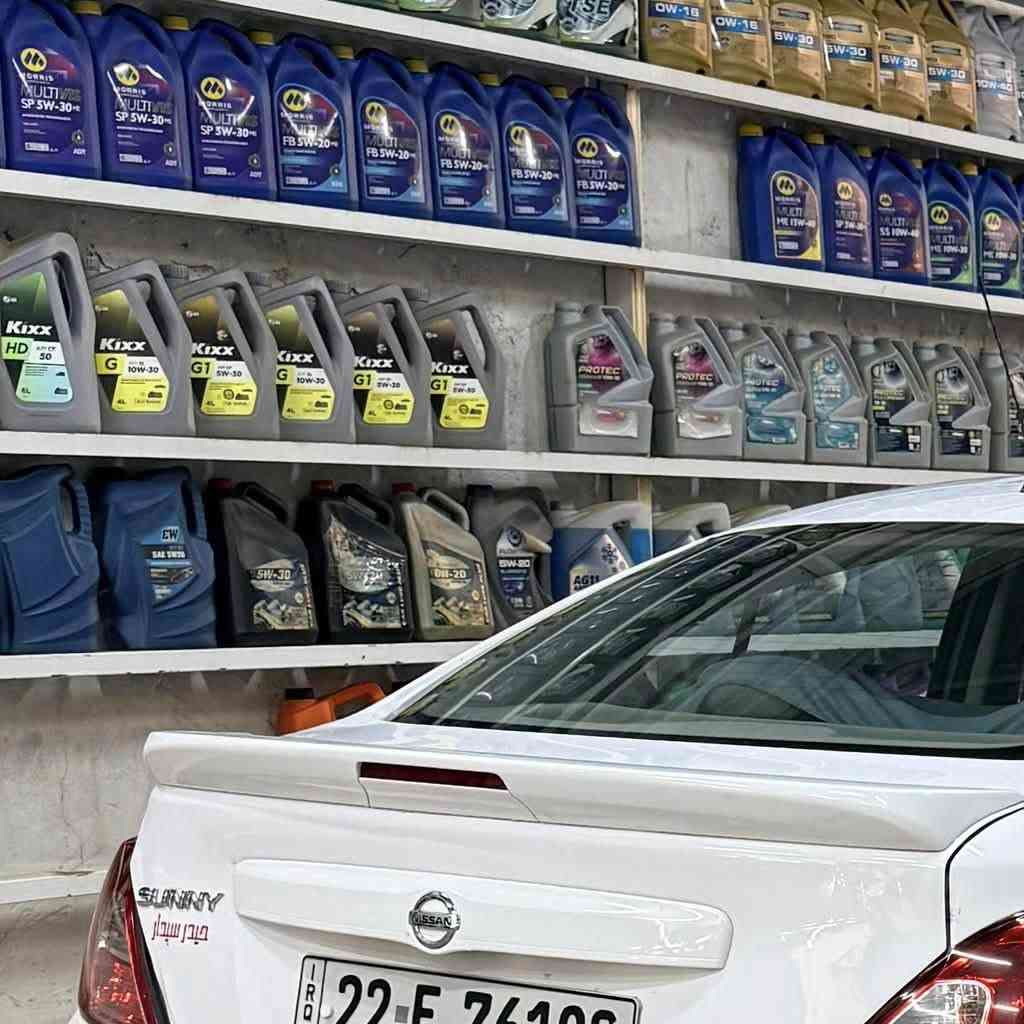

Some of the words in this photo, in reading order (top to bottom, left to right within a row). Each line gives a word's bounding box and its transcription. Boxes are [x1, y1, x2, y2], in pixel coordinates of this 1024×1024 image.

[21, 99, 35, 110] SP
[36, 100, 71, 112] 5W-30
[115, 111, 129, 122] SP
[130, 112, 164, 125] 5W-30
[200, 125, 213, 136] SP
[6, 320, 53, 336] Kixx
[5, 342, 29, 355] HD
[100, 337, 147, 351] Kixx
[192, 342, 235, 356] Kixx
[277, 350, 315, 364] Kixx
[354, 355, 394, 368] Kixx
[105, 357, 118, 371] G
[191, 361, 211, 375] G1
[431, 361, 469, 374] Kixx
[276, 368, 289, 381] G
[354, 374, 371, 387] G1
[430, 379, 448, 391] G1
[256, 569, 291, 580] 5W-30
[137, 887, 224, 912] SUNNY
[413, 912, 452, 926] NISSAN
